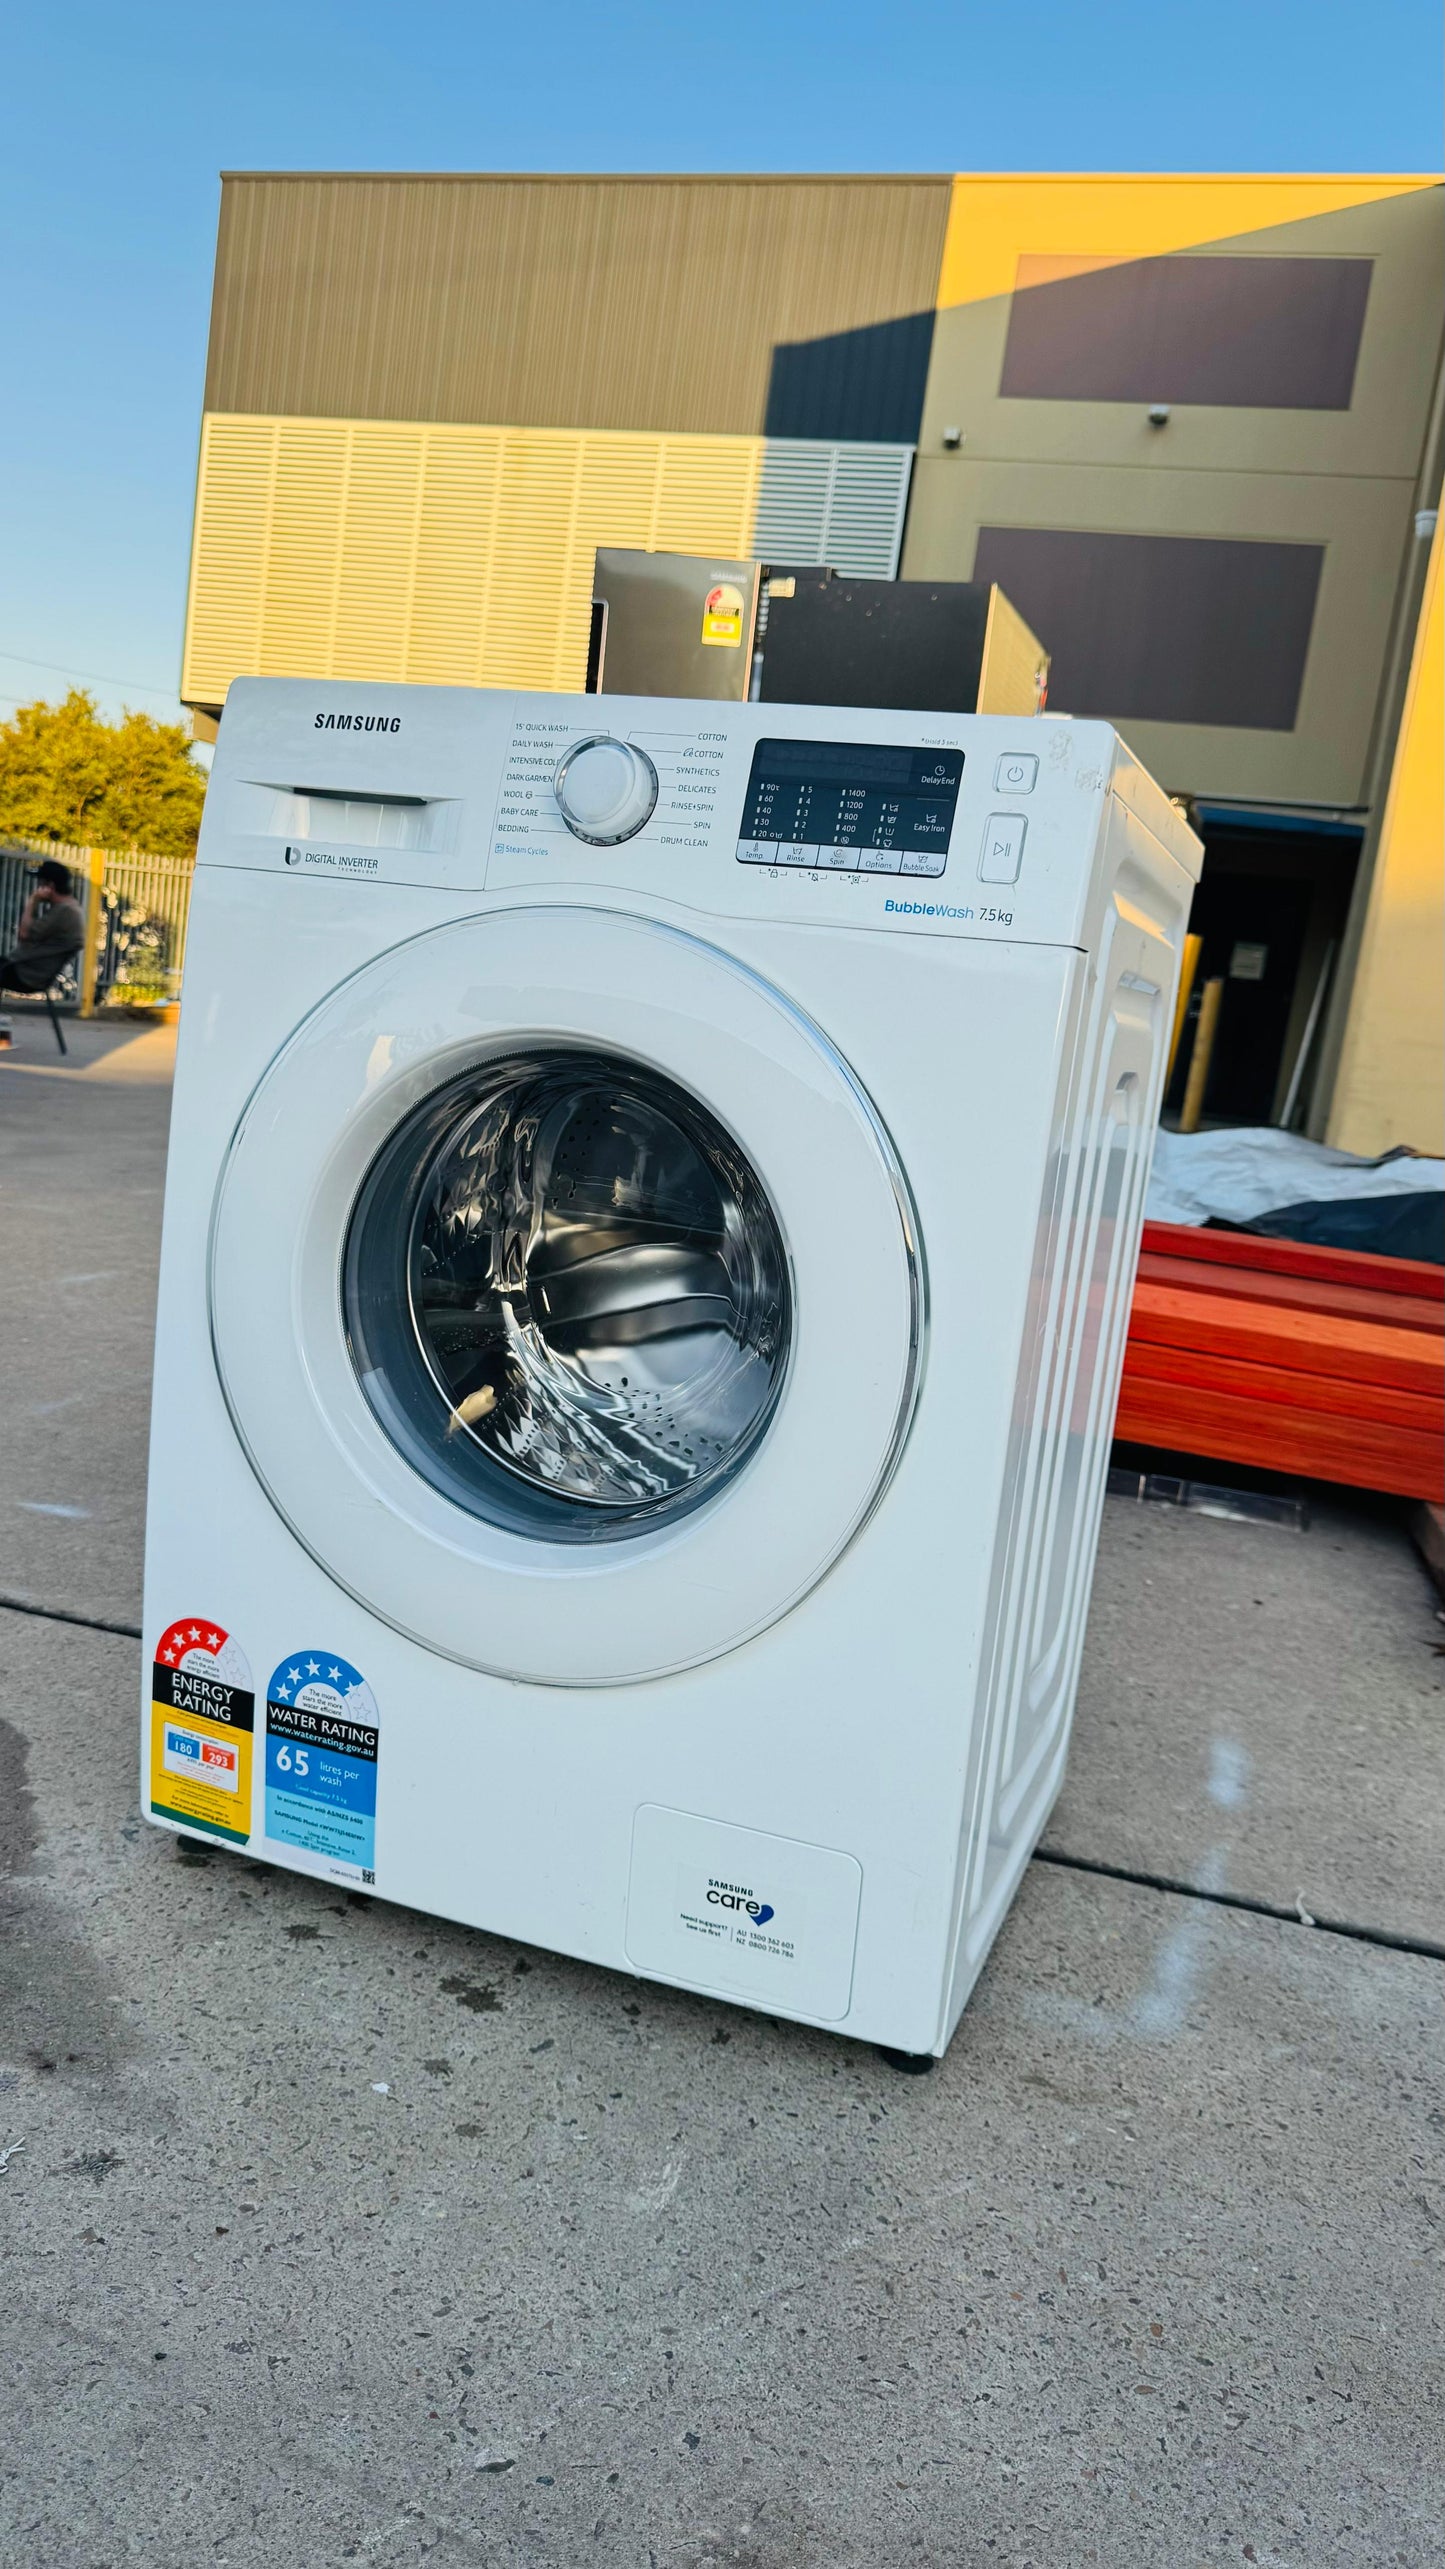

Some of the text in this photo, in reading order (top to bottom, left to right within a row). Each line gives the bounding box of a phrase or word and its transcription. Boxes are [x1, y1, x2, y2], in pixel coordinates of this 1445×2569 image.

[314, 713, 401, 733] SAMSUNG
[525, 723, 547, 732] QUICK
[548, 724, 569, 732] WASH
[698, 732, 728, 742] COTTON
[512, 740, 554, 749] DAILY WASH
[694, 750, 724, 760] COTTON
[509, 757, 542, 766] INTENSIVE
[676, 766, 720, 776] SYNTHETICS
[506, 773, 554, 783] DARK GARMEN
[921, 775, 955, 785] Delay End
[503, 790, 524, 798] WOOL
[678, 784, 717, 794] DELICATES
[849, 789, 866, 797] 1400
[501, 807, 539, 817] BABY CARE
[670, 801, 714, 812] RINSE+SPIN
[498, 824, 529, 833] BEDDING
[693, 821, 711, 830] SPIN
[913, 823, 946, 832] Easy Iron
[660, 836, 709, 848] DRUM CLEAN
[505, 845, 549, 856] Steam Cycles
[305, 853, 378, 869] DIGITAL INVERTER
[786, 854, 805, 862] Rinse
[830, 857, 844, 866] Spin
[865, 860, 892, 869] Options
[903, 863, 940, 873] Bubble Soak
[338, 866, 378, 875] TECHNOLOGY
[884, 899, 974, 919] BubbleWash
[172, 1672, 234, 1704] ENERGY
[309, 1688, 337, 1701] The more
[173, 1690, 232, 1721] RATING
[302, 1695, 343, 1710] stars the more
[303, 1702, 342, 1716] water efficient
[269, 1703, 318, 1731] WATER
[321, 1720, 375, 1746] RATING
[270, 1722, 374, 1757] www.waterrating.gov.au
[174, 1740, 192, 1755] 180
[209, 1752, 229, 1767] 293
[276, 1745, 309, 1777] 65
[320, 1761, 360, 1780] litres per
[320, 1775, 342, 1787] wash
[708, 1878, 754, 1897] SAMSUNG
[706, 1890, 760, 1915] care
[680, 1913, 728, 1931] Need support?
[686, 1923, 698, 1931] See
[708, 1928, 721, 1938] first
[736, 1929, 747, 1937] AU
[750, 1932, 767, 1943] 1300
[736, 1937, 746, 1945] NZ
[748, 1940, 767, 1951] 0800
